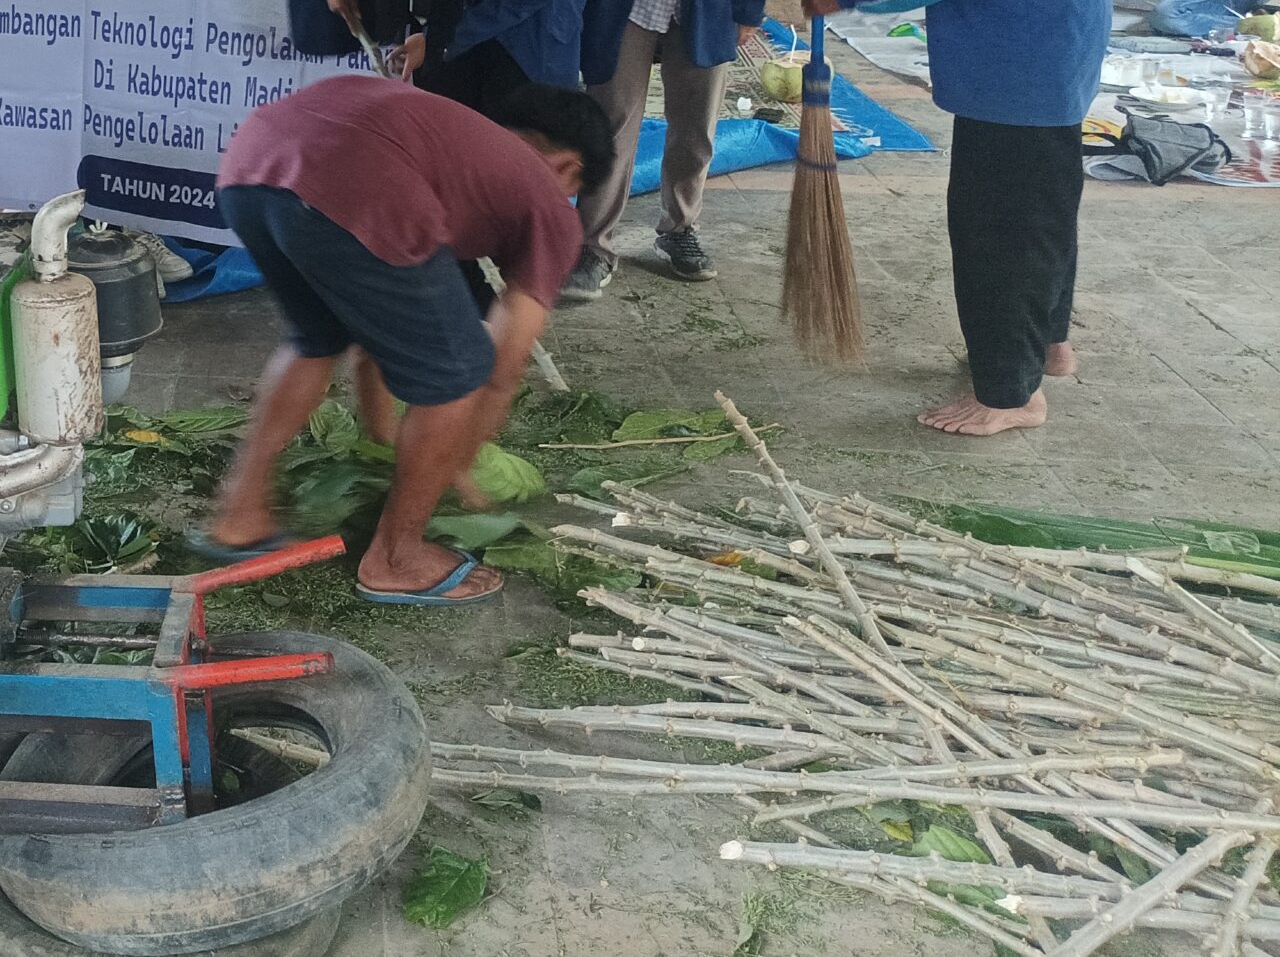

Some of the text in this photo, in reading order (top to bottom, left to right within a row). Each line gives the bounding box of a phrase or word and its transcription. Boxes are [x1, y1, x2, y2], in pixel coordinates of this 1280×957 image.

[91, 10, 194, 59] Teknologi
[93, 59, 115, 90] Di
[127, 62, 231, 108] Kabupaten
[83, 103, 205, 151] Pengelolaan
[101, 172, 216, 209] TAHUN 2024
